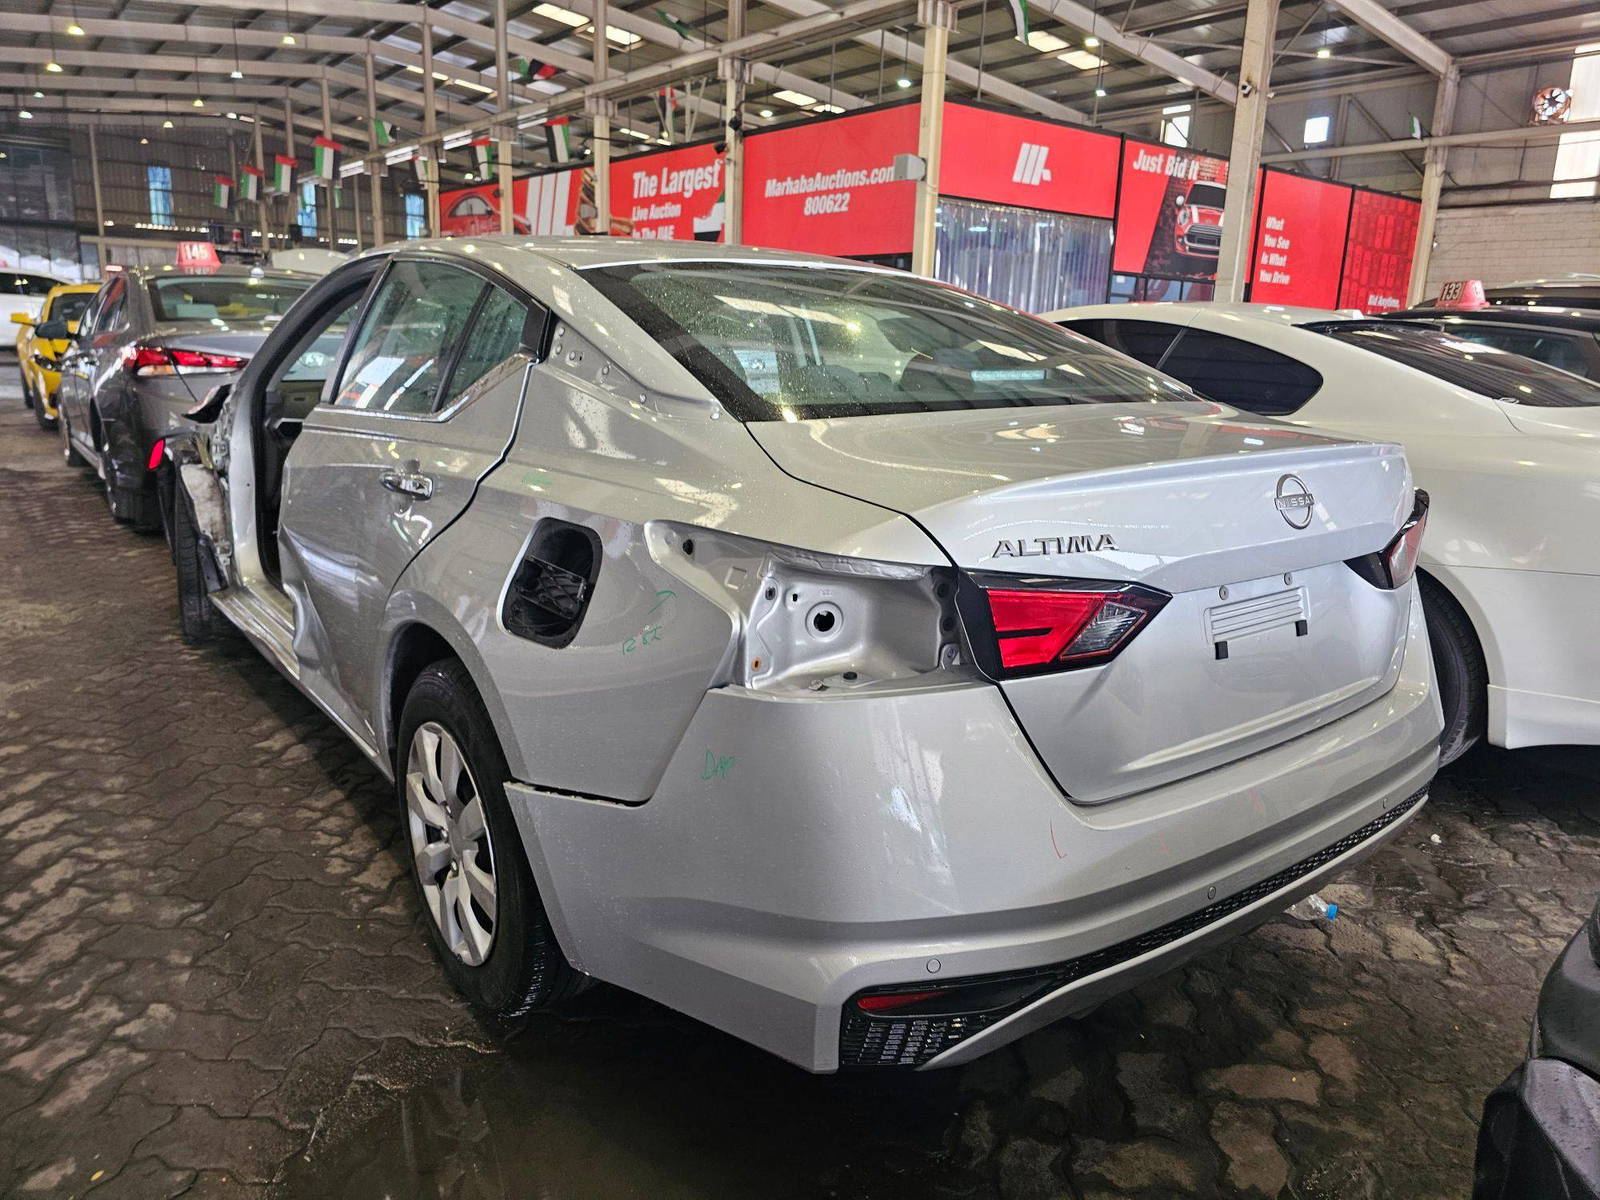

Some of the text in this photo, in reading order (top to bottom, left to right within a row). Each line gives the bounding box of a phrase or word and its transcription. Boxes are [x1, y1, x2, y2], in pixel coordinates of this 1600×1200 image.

[1133, 150, 1200, 180] Just Bid It
[632, 159, 723, 199] The Largest
[632, 202, 682, 221] Live Auction
[804, 193, 850, 215] 800622
[1266, 216, 1284, 230] What
[1264, 233, 1290, 249] You See
[1260, 252, 1287, 267] Is What
[1260, 270, 1290, 284] You Drive
[1441, 281, 1463, 300] 133
[992, 533, 1120, 558] ALTIMA
